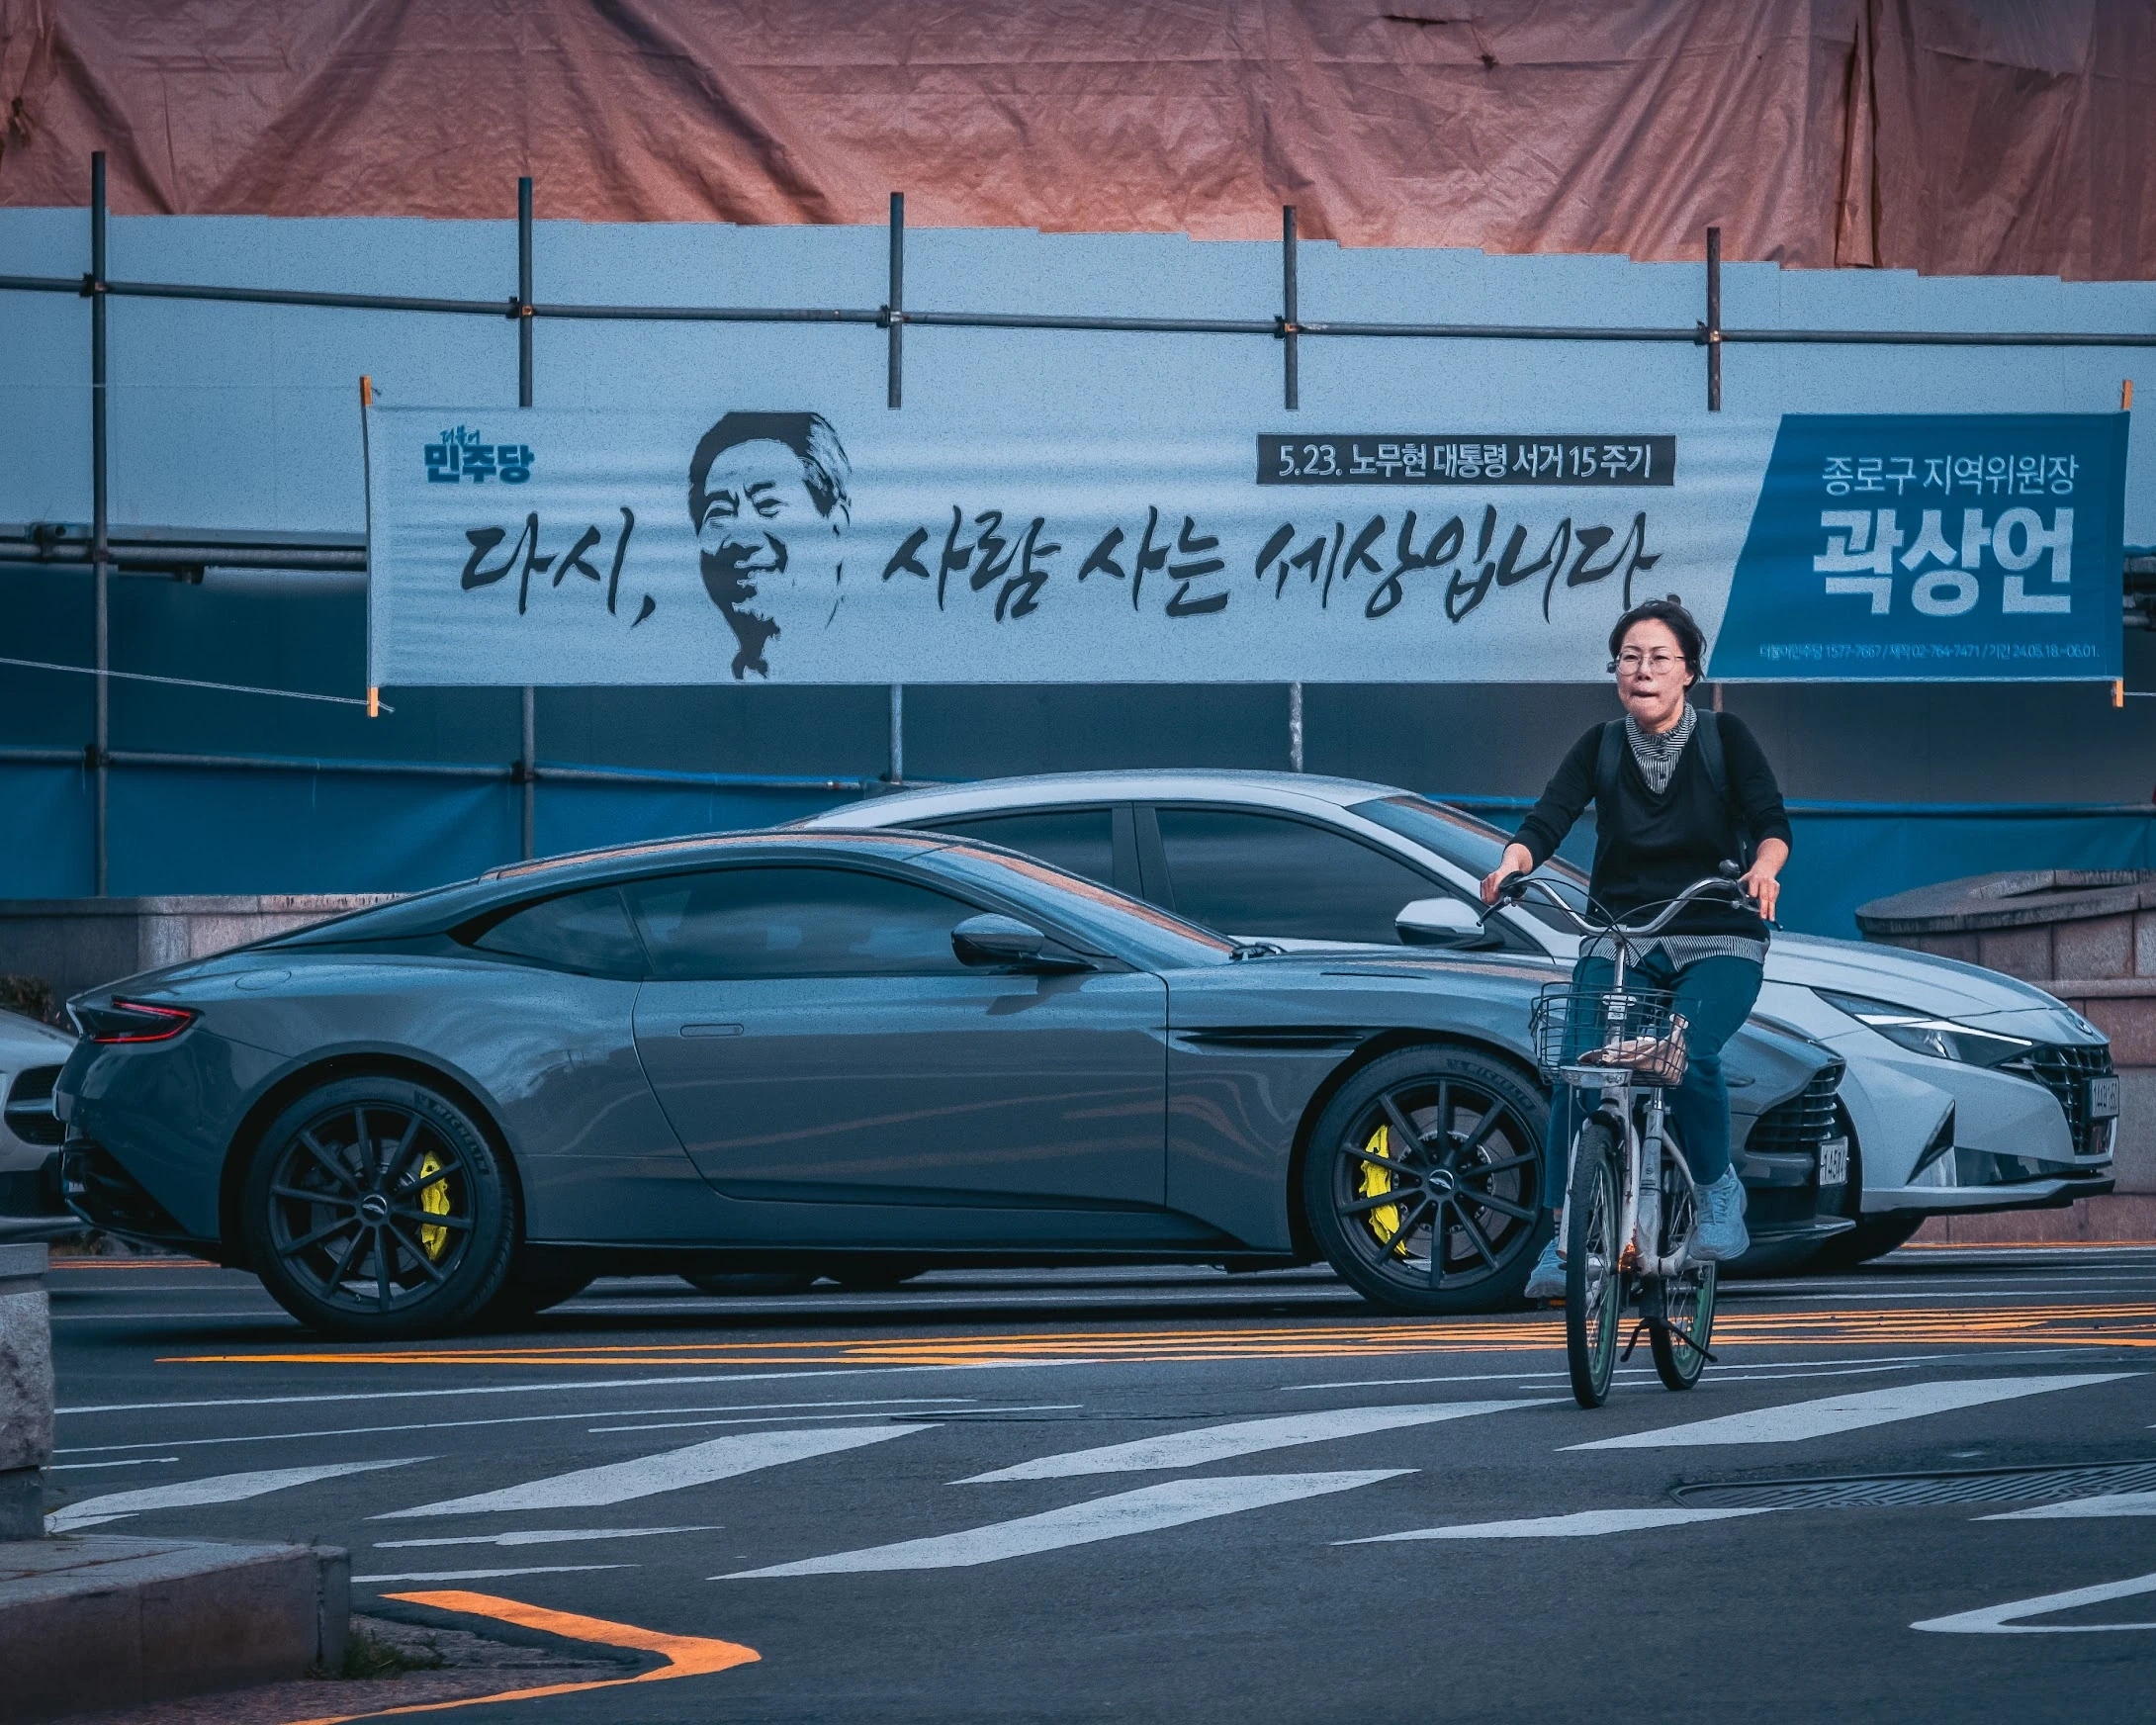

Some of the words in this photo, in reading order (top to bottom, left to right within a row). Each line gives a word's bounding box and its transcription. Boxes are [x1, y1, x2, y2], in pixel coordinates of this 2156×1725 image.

[440, 425, 481, 445] 더불어
[424, 444, 536, 486] 민주당
[1279, 444, 1343, 477] 5.23.
[1350, 443, 1427, 479] 노무현
[1434, 443, 1508, 479] 대통령
[1512, 443, 1564, 479] 서거
[1822, 456, 1918, 496] 종로구
[1924, 454, 2080, 496] 지역위원장
[461, 506, 657, 629] 다시,
[883, 505, 1062, 624] 사람
[1078, 505, 1230, 620] 사는
[1813, 506, 2076, 617] 곽상언
[432, 1102, 489, 1171] MICHELIN
